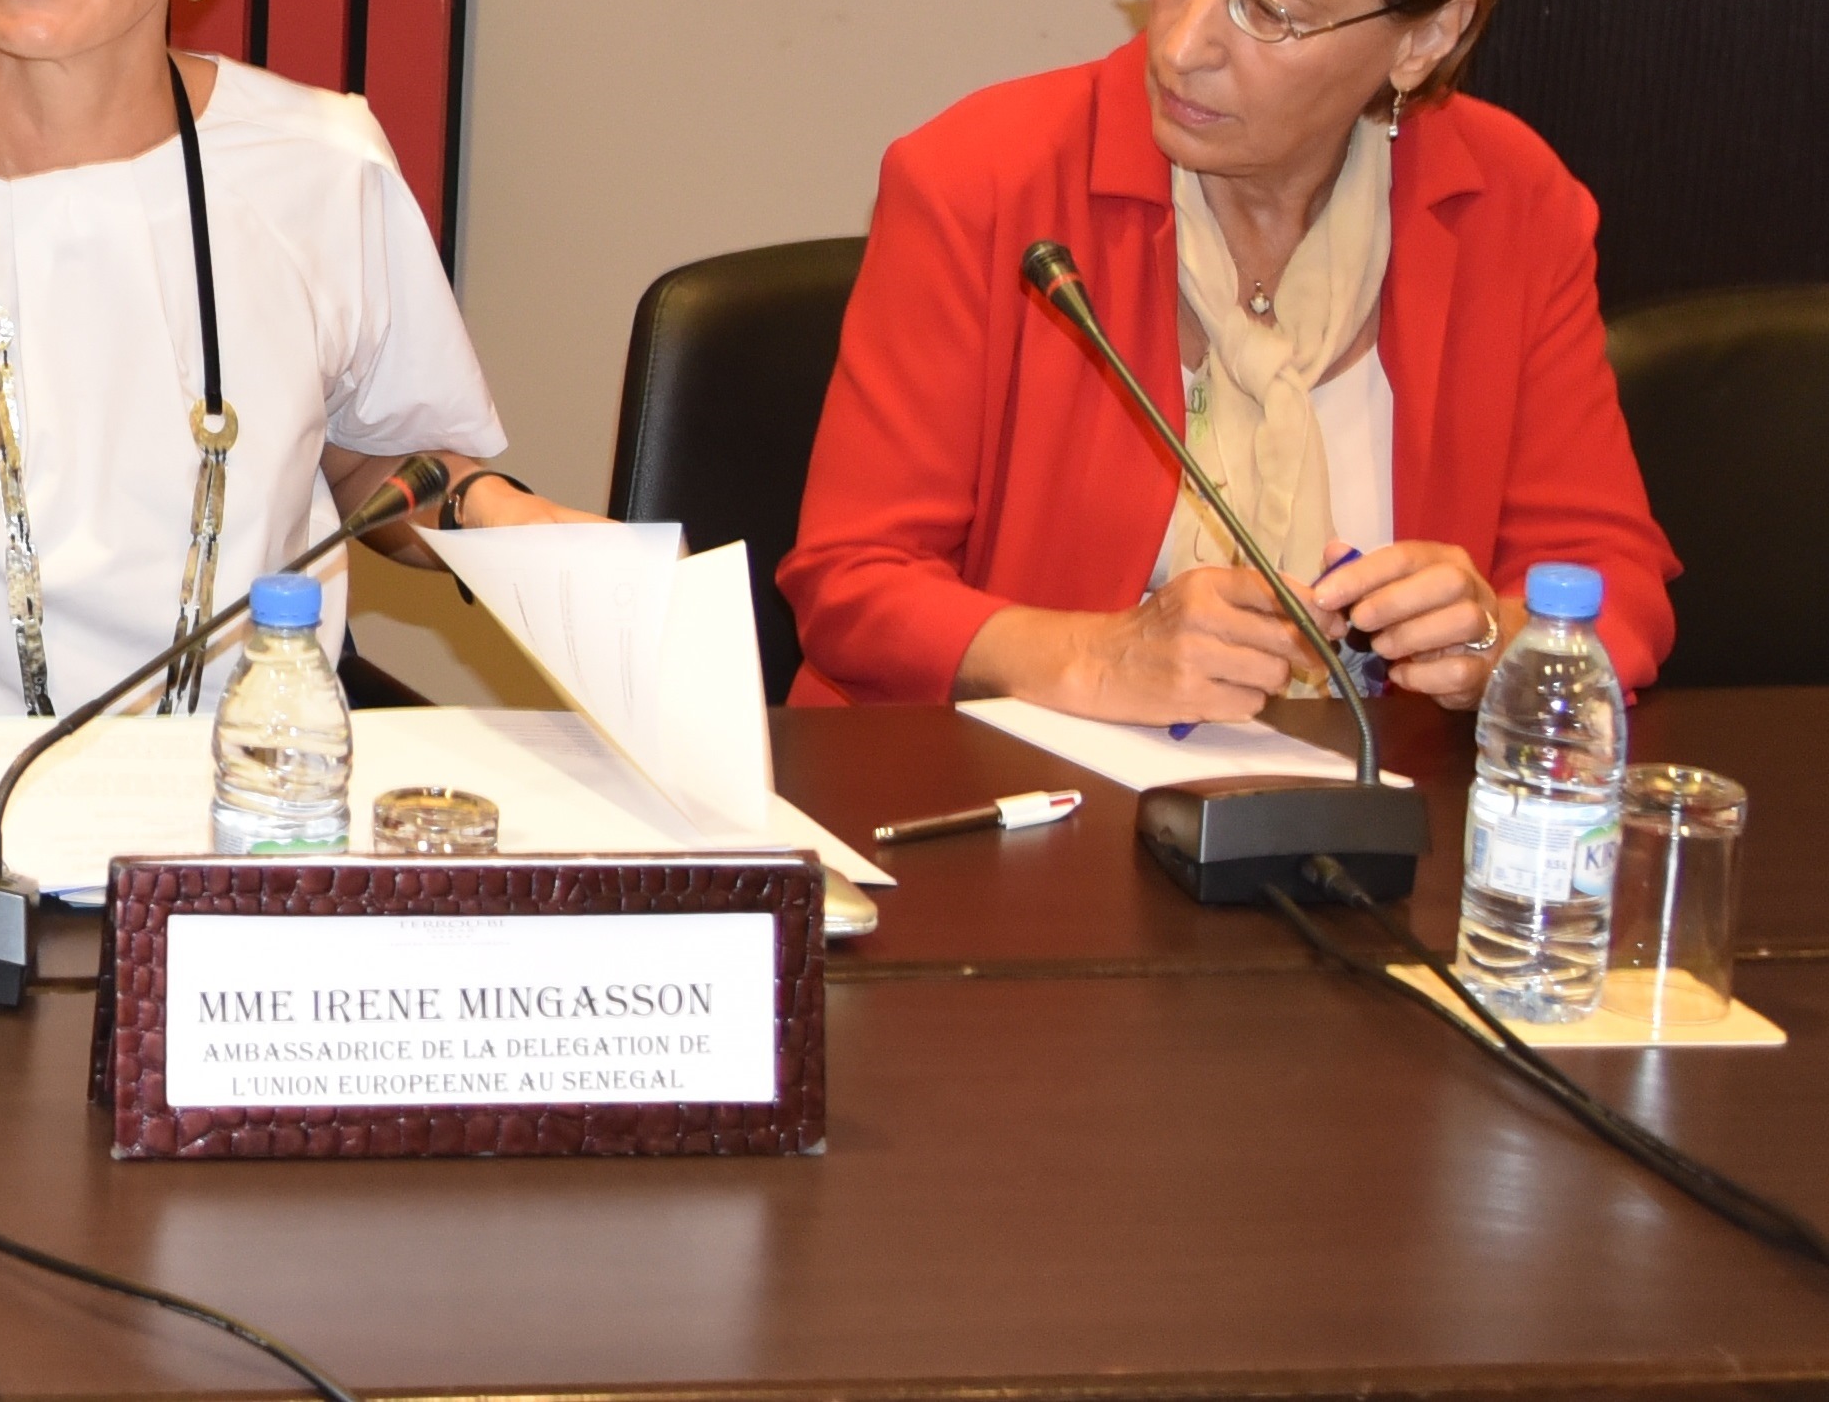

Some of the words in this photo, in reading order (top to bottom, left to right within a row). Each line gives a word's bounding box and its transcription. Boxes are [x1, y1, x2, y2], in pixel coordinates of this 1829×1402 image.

[198, 989, 294, 1024] MME
[312, 987, 442, 1024] IRENE
[457, 982, 713, 1021] MINGASSON
[203, 1040, 413, 1063] AMBASSADRICE
[421, 1039, 454, 1060] DE
[462, 1038, 496, 1059] LA
[506, 1035, 669, 1059] DELEGATION
[679, 1034, 711, 1056] DE
[231, 1075, 329, 1097] L'UNION
[338, 1072, 508, 1095] EUROPEENNE
[518, 1071, 553, 1093] AU
[562, 1069, 684, 1092] SENEGAL
